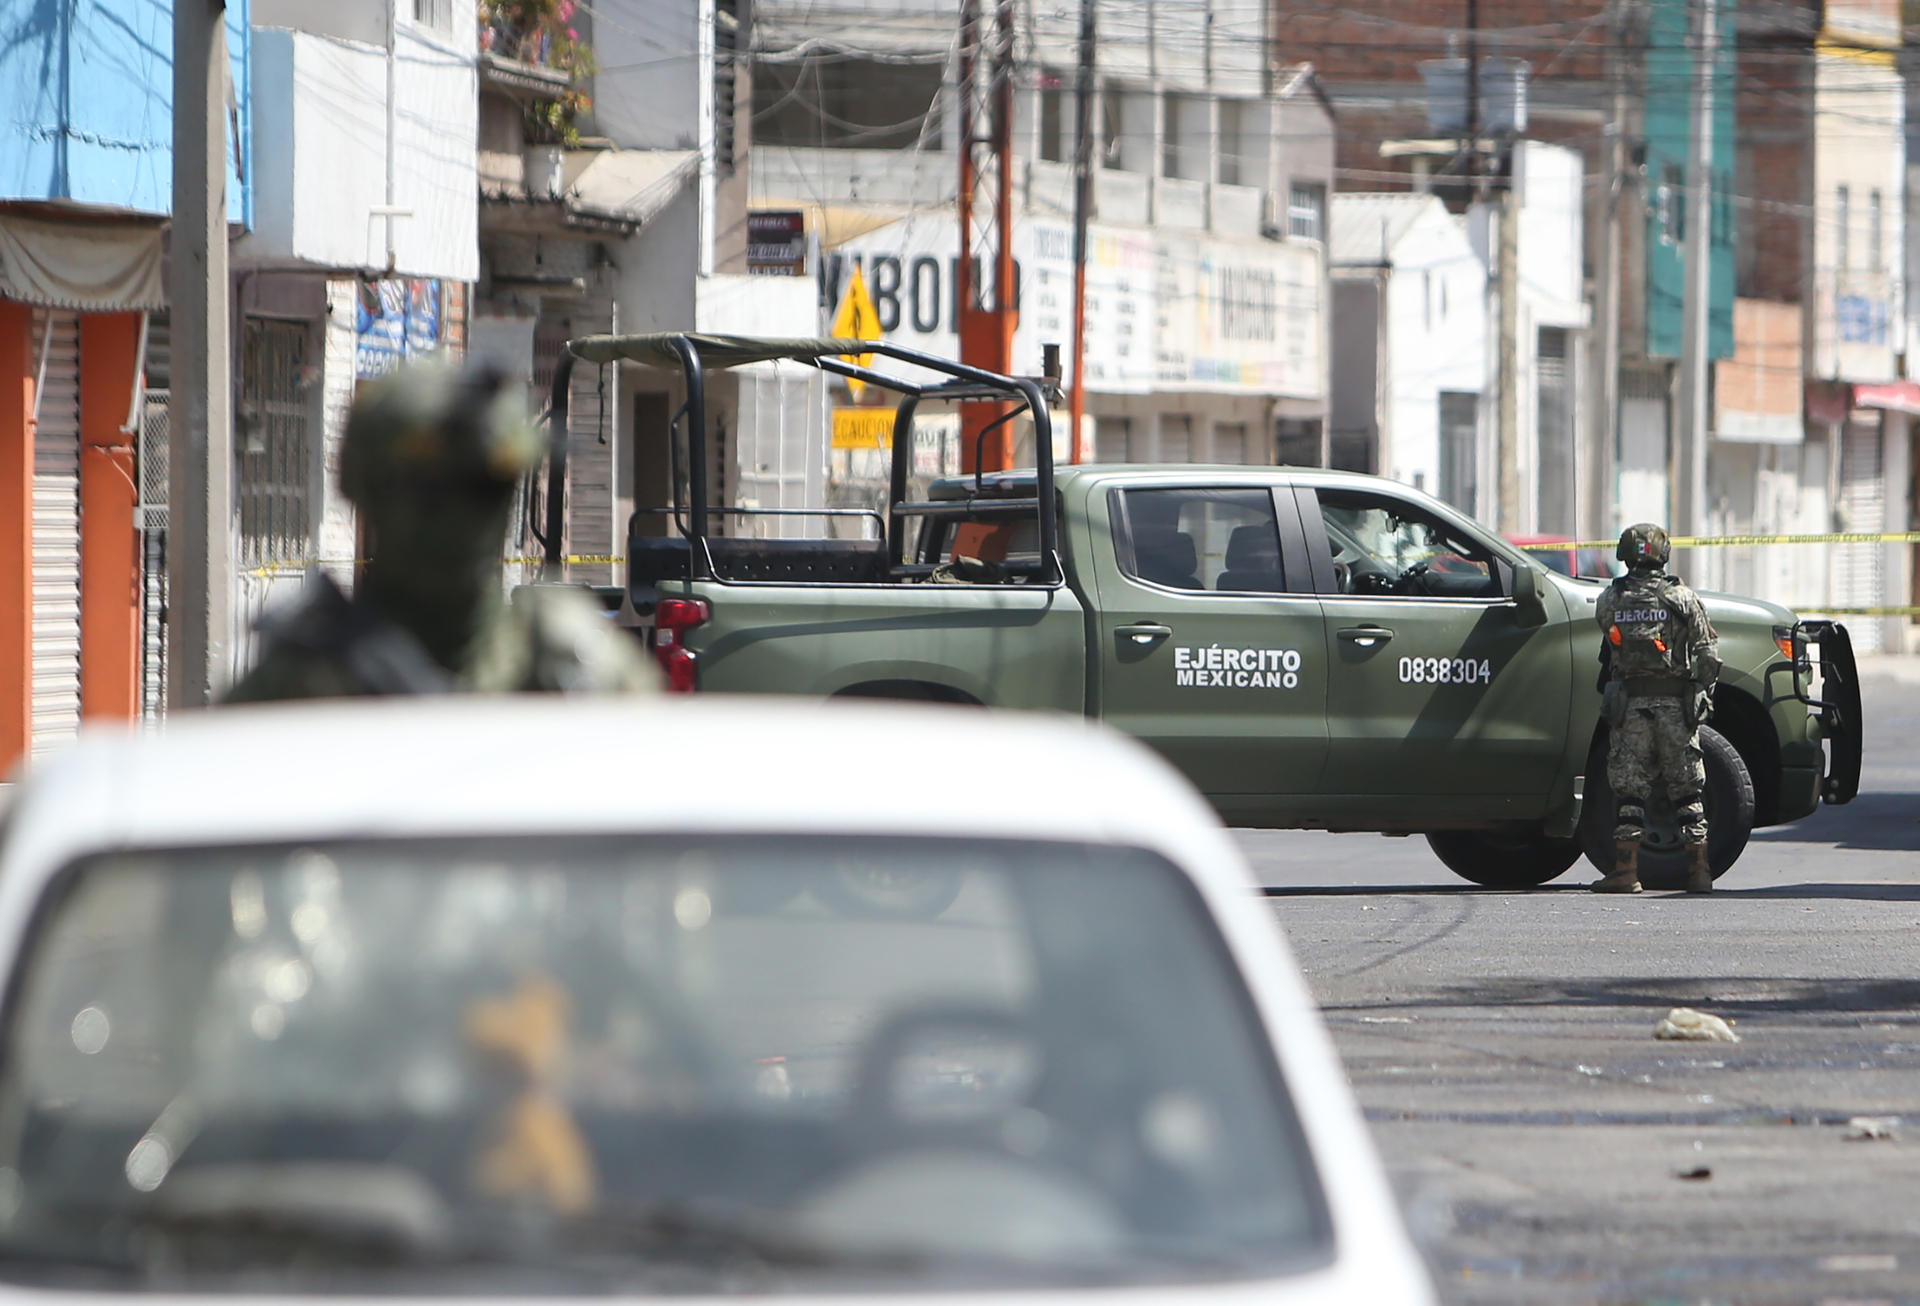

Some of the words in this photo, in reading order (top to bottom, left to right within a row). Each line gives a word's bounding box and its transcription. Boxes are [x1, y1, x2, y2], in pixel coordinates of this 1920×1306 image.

[833, 417, 893, 440] ECAUCION
[1174, 643, 1301, 672] EJÉRCITO
[1399, 656, 1491, 684] 0838304
[1176, 669, 1299, 689] MEXICANO
